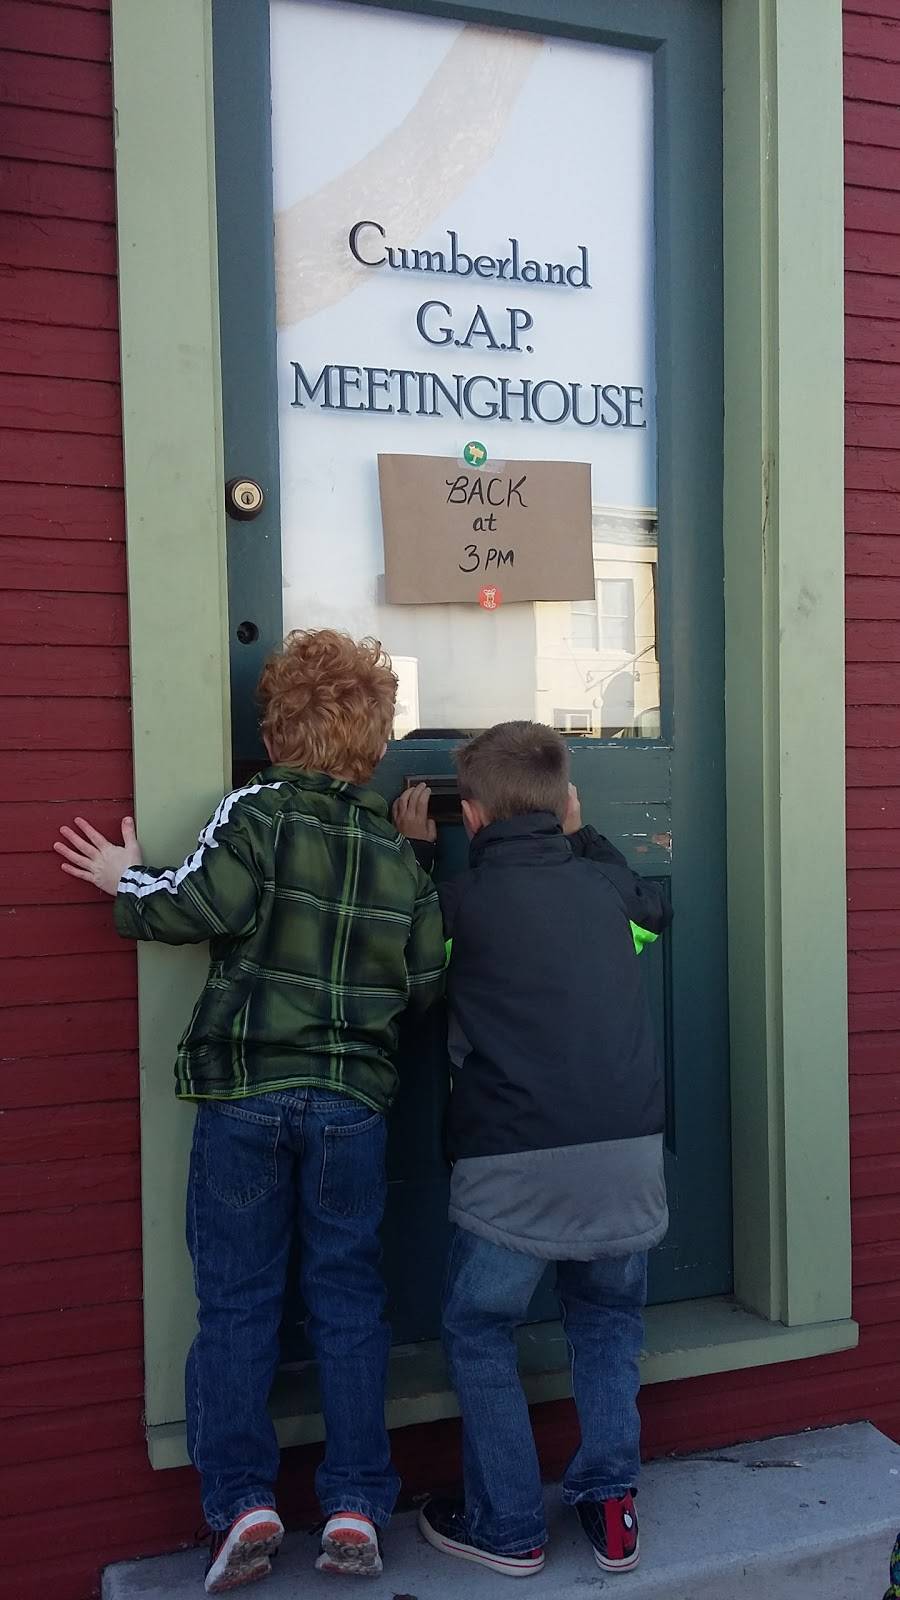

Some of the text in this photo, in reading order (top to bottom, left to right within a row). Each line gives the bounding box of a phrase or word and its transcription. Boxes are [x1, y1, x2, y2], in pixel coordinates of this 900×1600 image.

[347, 220, 592, 289] Cumberland
[416, 300, 534, 352] G.A.P.
[290, 361, 647, 428] MEETINGHOUSE
[446, 475, 528, 508] BACK
[472, 513, 497, 531] at
